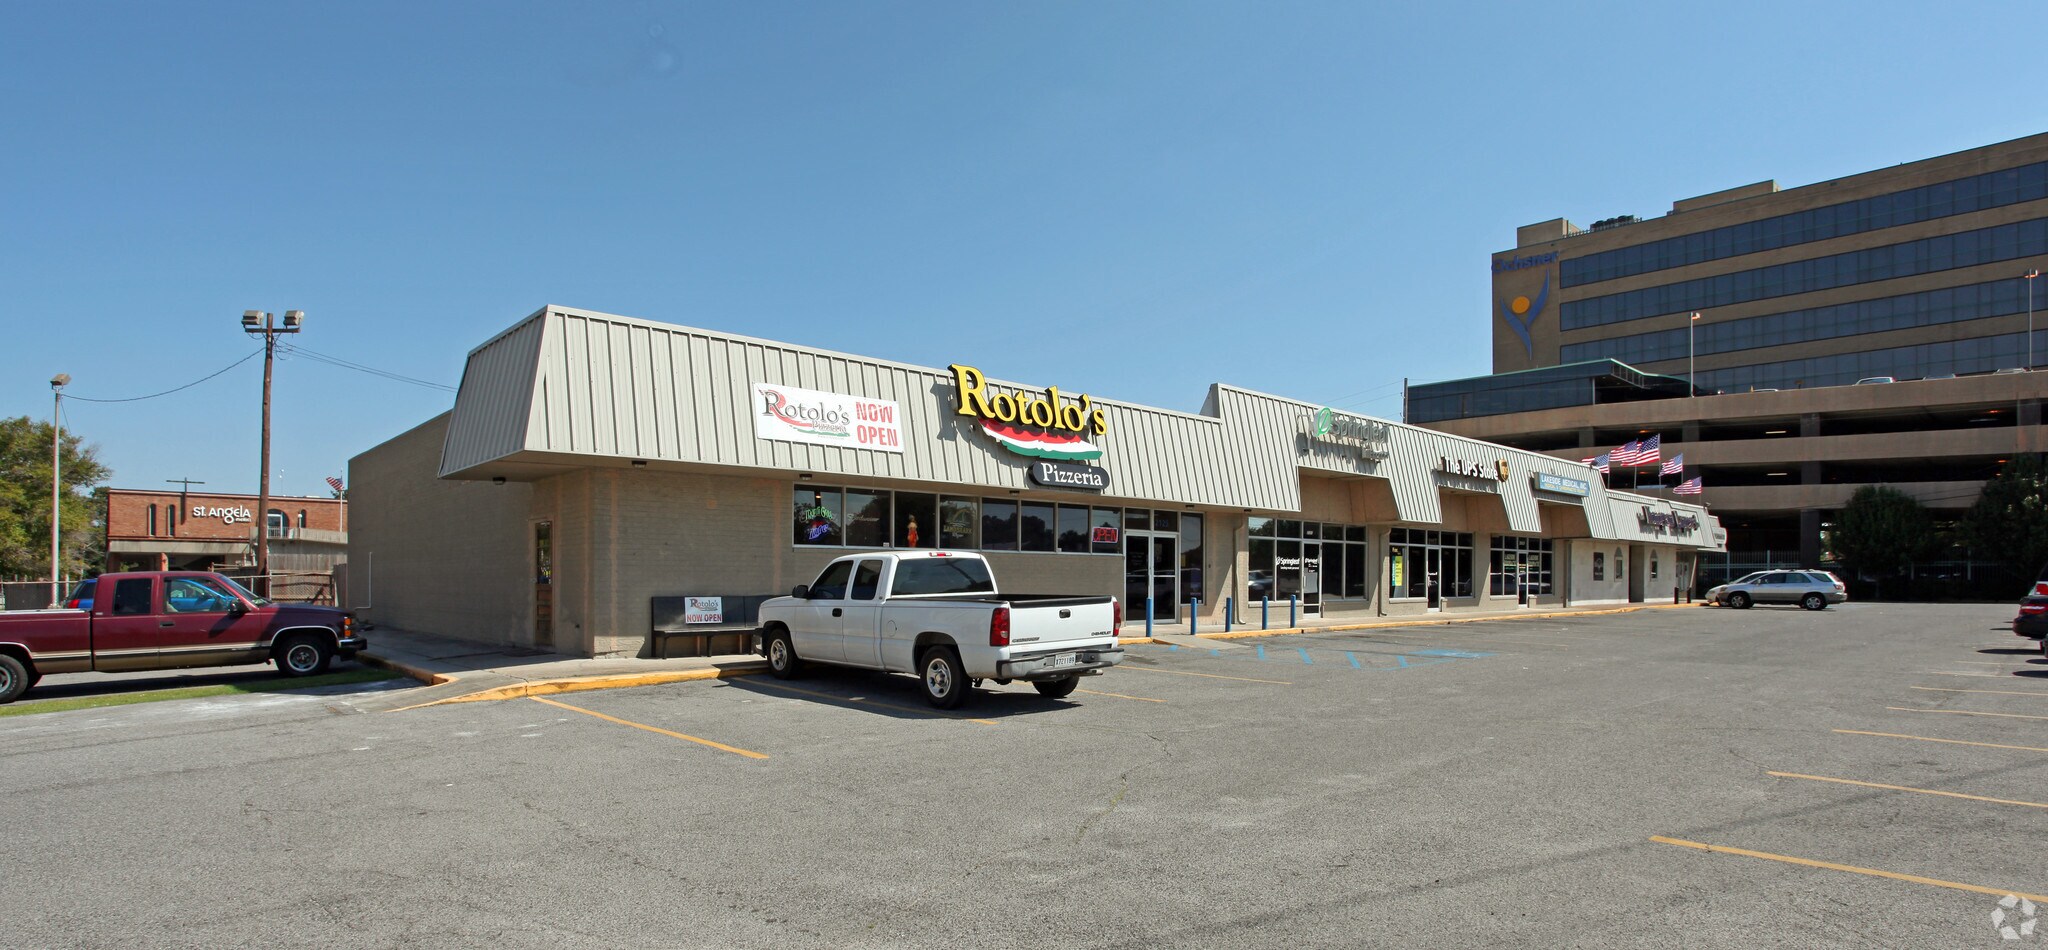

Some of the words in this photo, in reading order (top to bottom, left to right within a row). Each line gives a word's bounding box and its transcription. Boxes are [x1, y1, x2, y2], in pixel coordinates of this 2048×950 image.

[759, 390, 850, 425] Rotolo's
[949, 364, 1107, 435] Rotolo's
[855, 401, 893, 424] NOW
[856, 425, 899, 447] OPEN
[1040, 462, 1103, 487] Pizzeria
[1445, 456, 1461, 475] The
[1462, 459, 1478, 478] UPS
[1479, 463, 1499, 481] Store
[1093, 528, 1117, 541] OPEN
[689, 598, 719, 609] Rotolo's
[687, 614, 703, 622] NOW
[704, 614, 722, 622] OPEN
